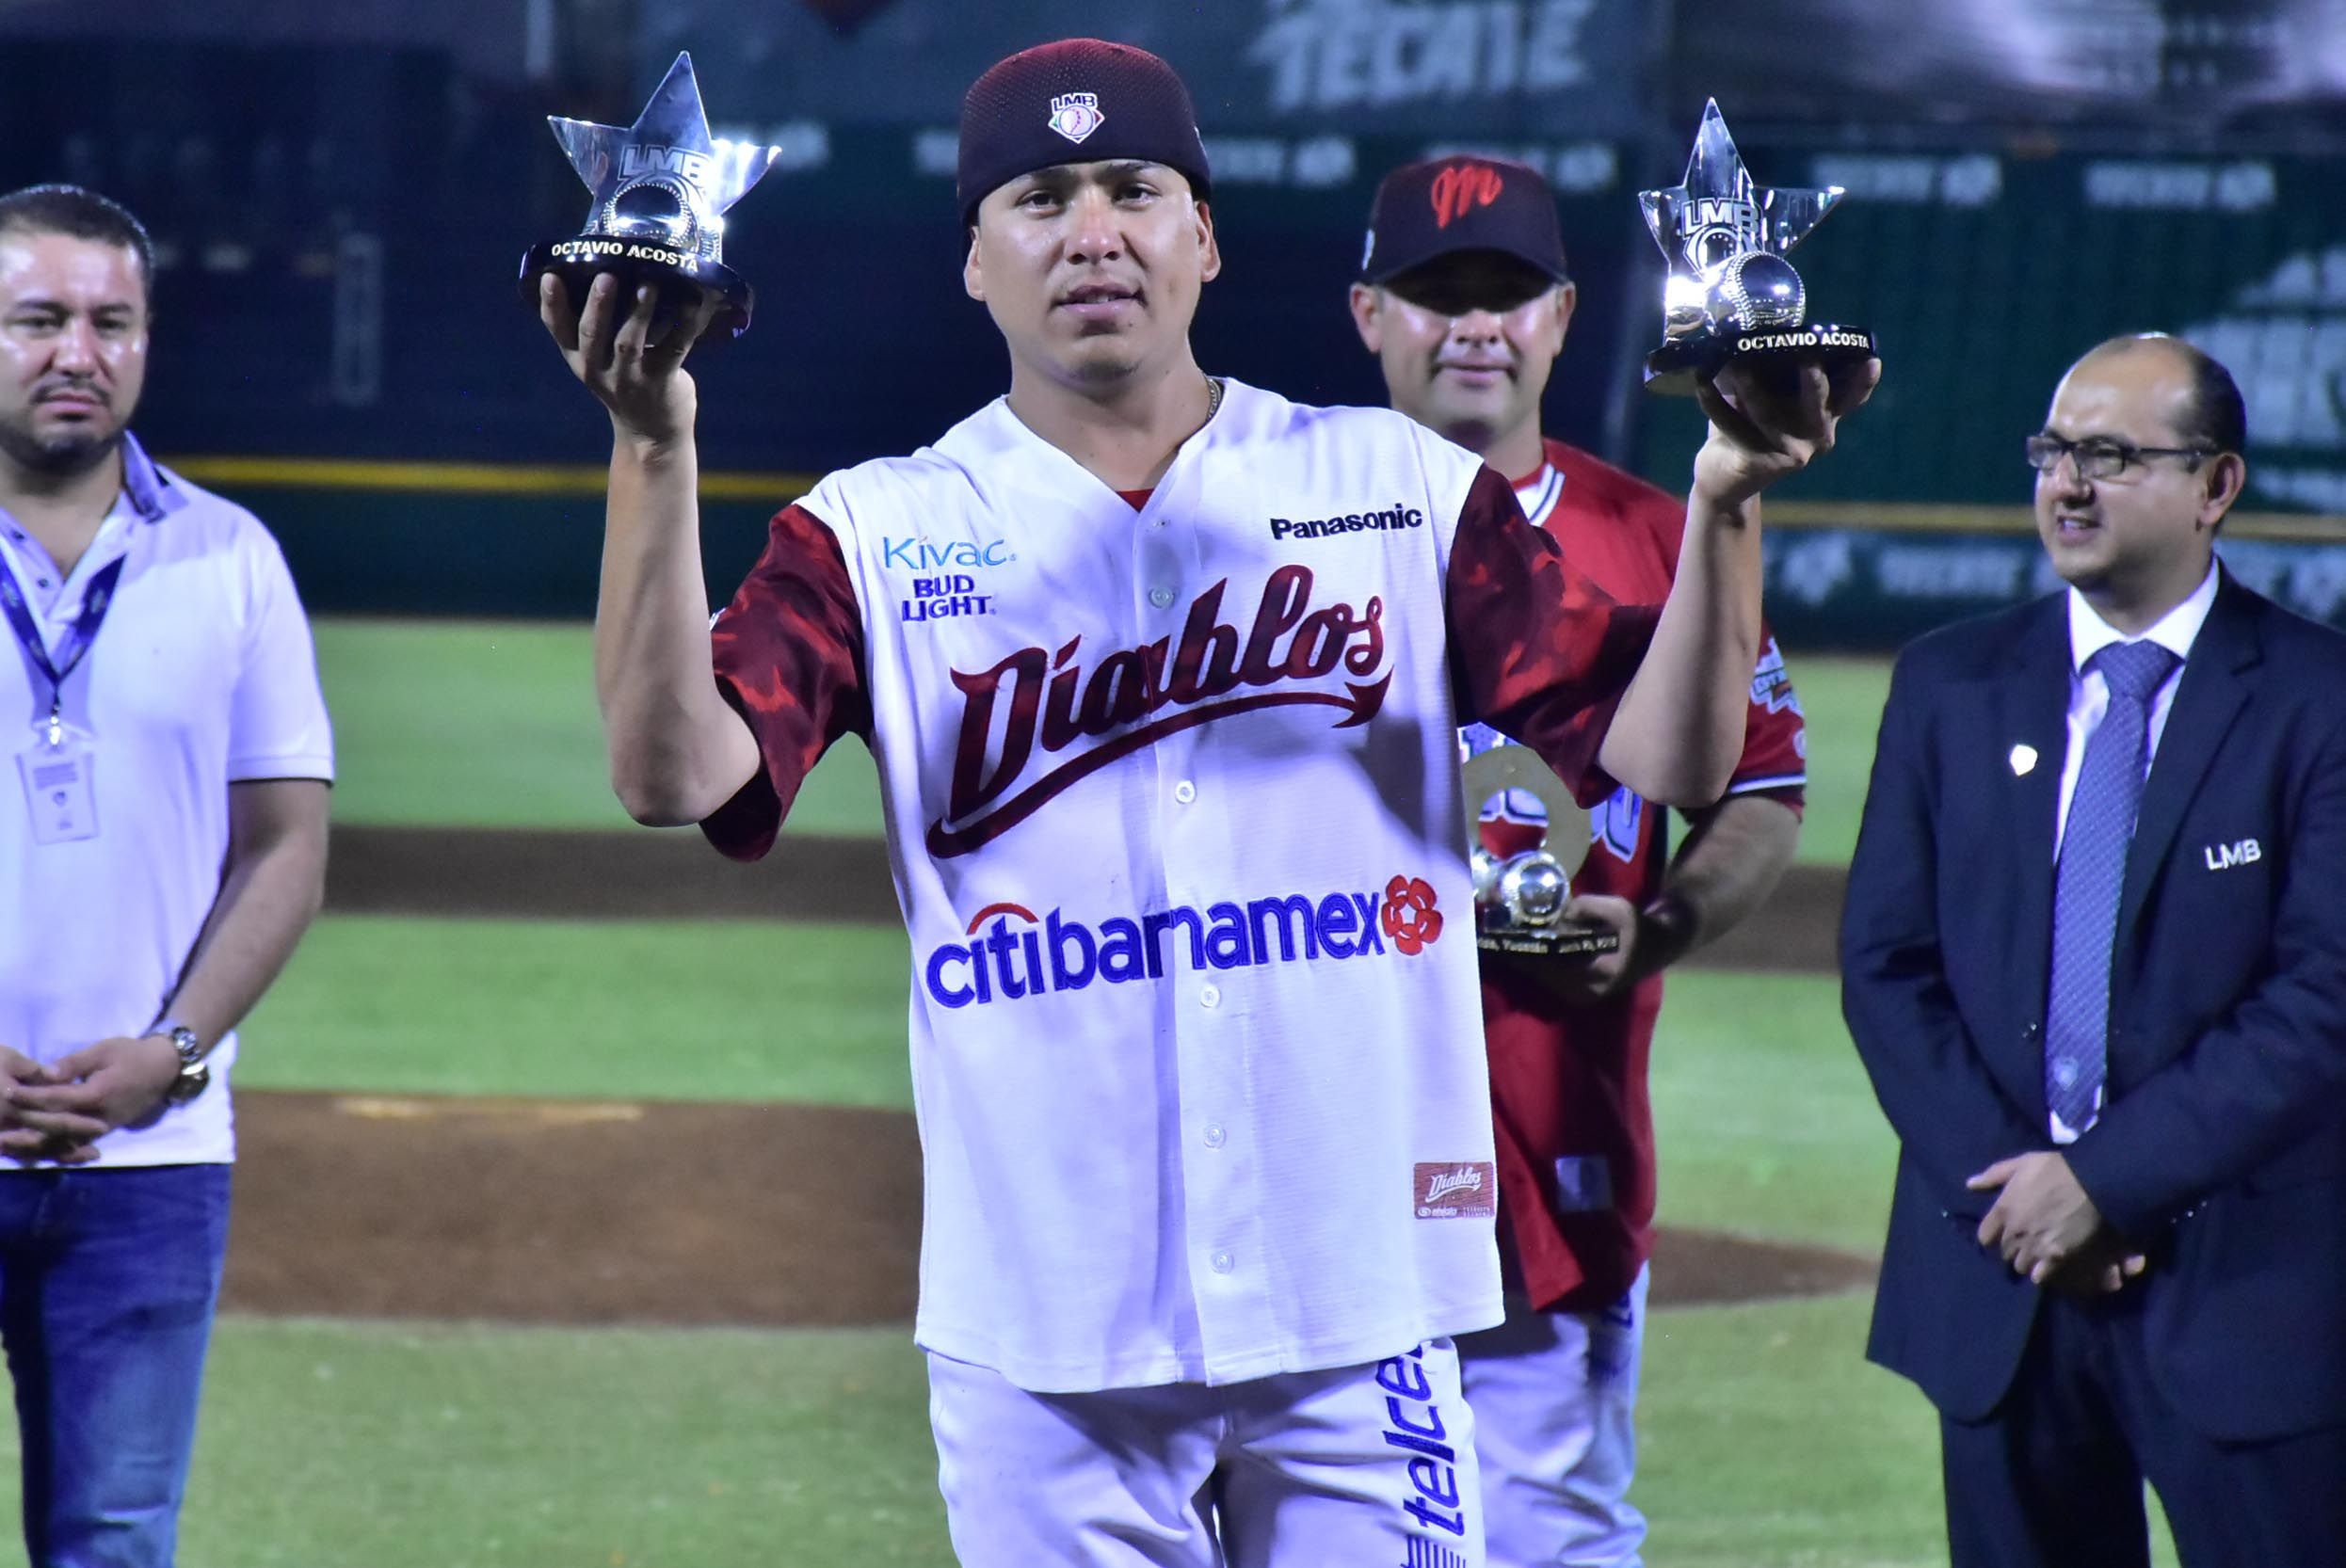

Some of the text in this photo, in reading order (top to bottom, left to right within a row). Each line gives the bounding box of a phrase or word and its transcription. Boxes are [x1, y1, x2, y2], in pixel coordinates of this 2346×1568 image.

[1052, 94, 1097, 112] LMB
[619, 145, 709, 182] LMB
[1683, 199, 1761, 236] LMB
[552, 241, 699, 272] OCTAVIO ACOSTA
[1738, 332, 1870, 351] OCTAVIO ACOSTA
[1270, 503, 1422, 540] Panasonic
[913, 574, 975, 599] BUD
[902, 595, 992, 621] LIGHT
[944, 565, 1389, 828] Diablos
[2206, 839, 2261, 871] LMB
[926, 891, 1385, 1008] citibanamex
[1375, 1343, 1465, 1537] telce
